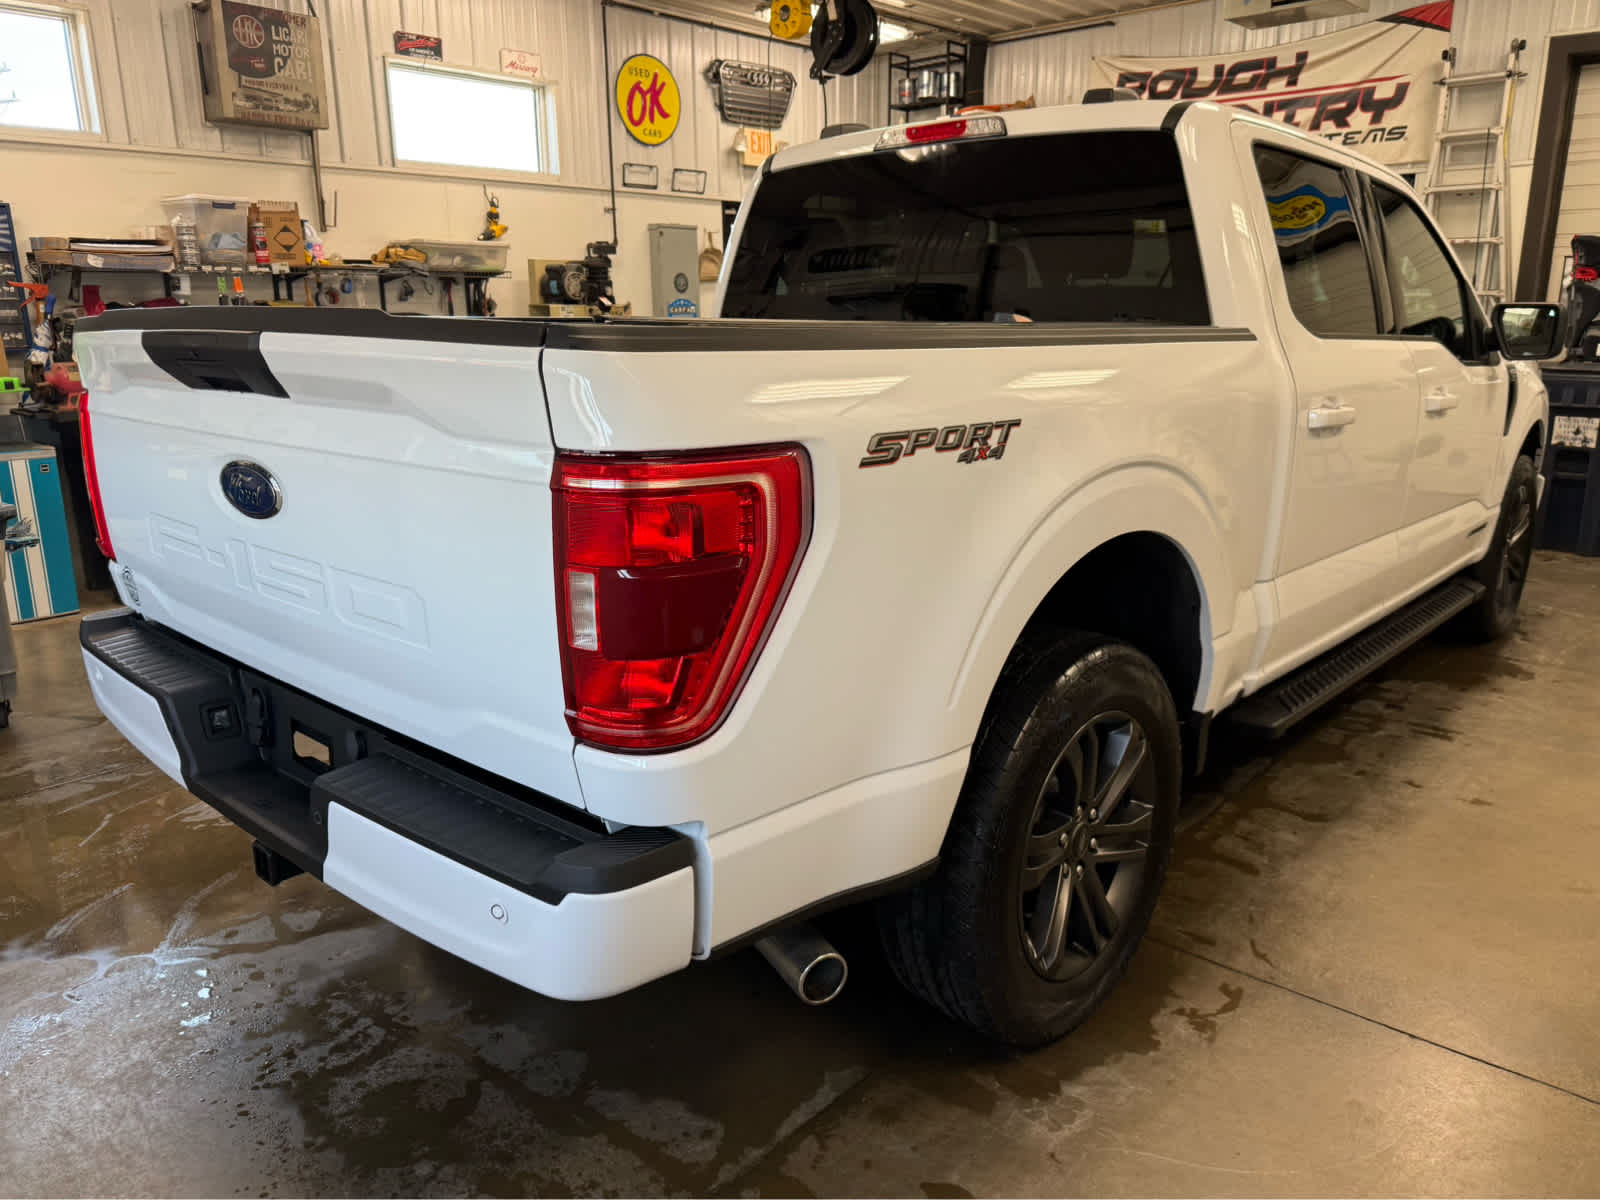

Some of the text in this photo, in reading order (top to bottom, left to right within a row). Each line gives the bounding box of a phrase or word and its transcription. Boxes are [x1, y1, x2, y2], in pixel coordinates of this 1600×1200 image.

[273, 43, 311, 60] MOTOR
[628, 66, 650, 78] USED
[1116, 51, 1308, 101] ROUGH
[627, 72, 671, 127] OK
[751, 131, 772, 153] EXIT
[1319, 126, 1408, 146] TEMS
[859, 418, 1022, 469] SPORT
[147, 511, 432, 652] F-150
